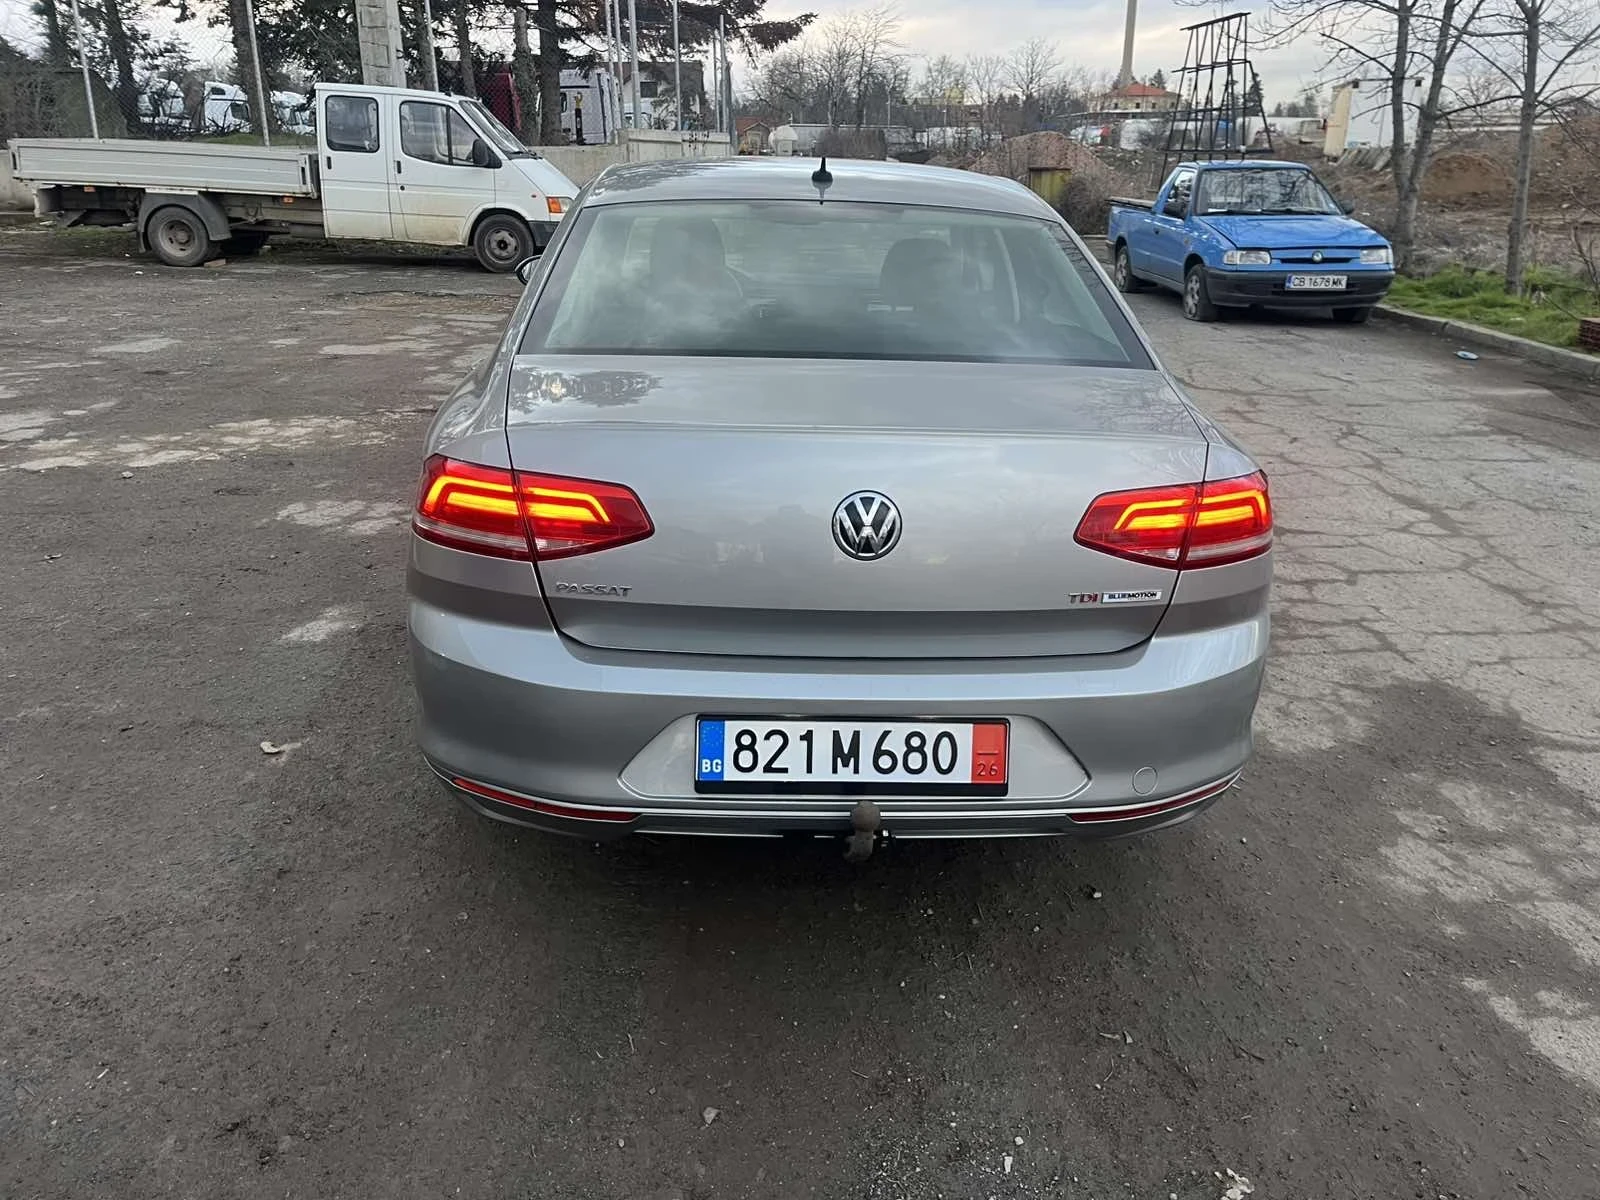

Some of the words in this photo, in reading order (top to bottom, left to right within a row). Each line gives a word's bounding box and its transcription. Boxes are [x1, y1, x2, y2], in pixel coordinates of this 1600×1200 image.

[1293, 276, 1305, 287] CB
[1309, 277, 1331, 288] 1678
[1332, 277, 1345, 288] MK
[555, 581, 633, 597] PASSAT
[1068, 591, 1099, 604] TDI
[1108, 591, 1157, 600] BLUEMOTION
[732, 728, 814, 774] 821
[831, 729, 860, 775] M
[872, 729, 958, 775] 680
[701, 758, 722, 773] BG
[976, 760, 998, 776] 26
